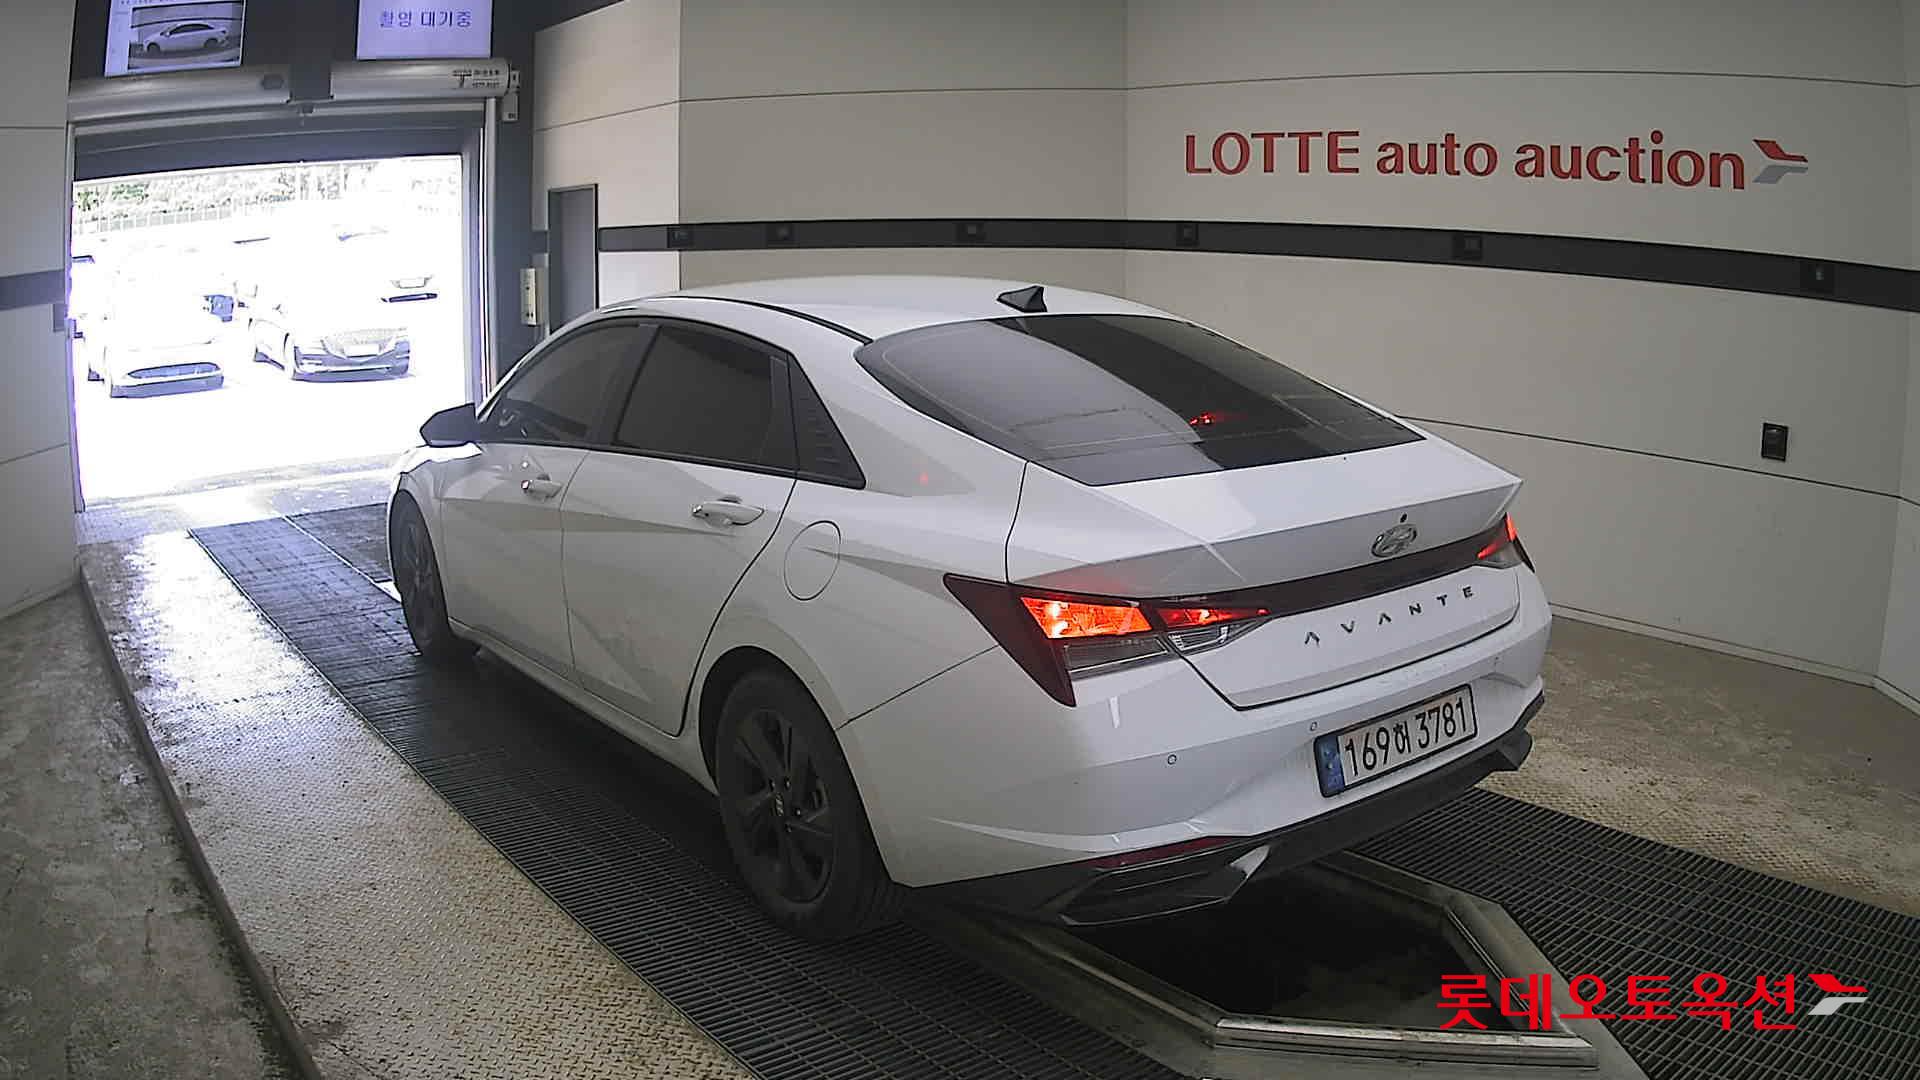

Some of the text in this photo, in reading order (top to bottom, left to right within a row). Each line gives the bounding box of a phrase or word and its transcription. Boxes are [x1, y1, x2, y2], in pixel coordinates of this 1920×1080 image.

[421, 10, 471, 28] 대기중
[1185, 129, 1745, 190] LOTTE auto auction
[1304, 586, 1474, 645] AVANTE
[1415, 697, 1466, 749] 3781
